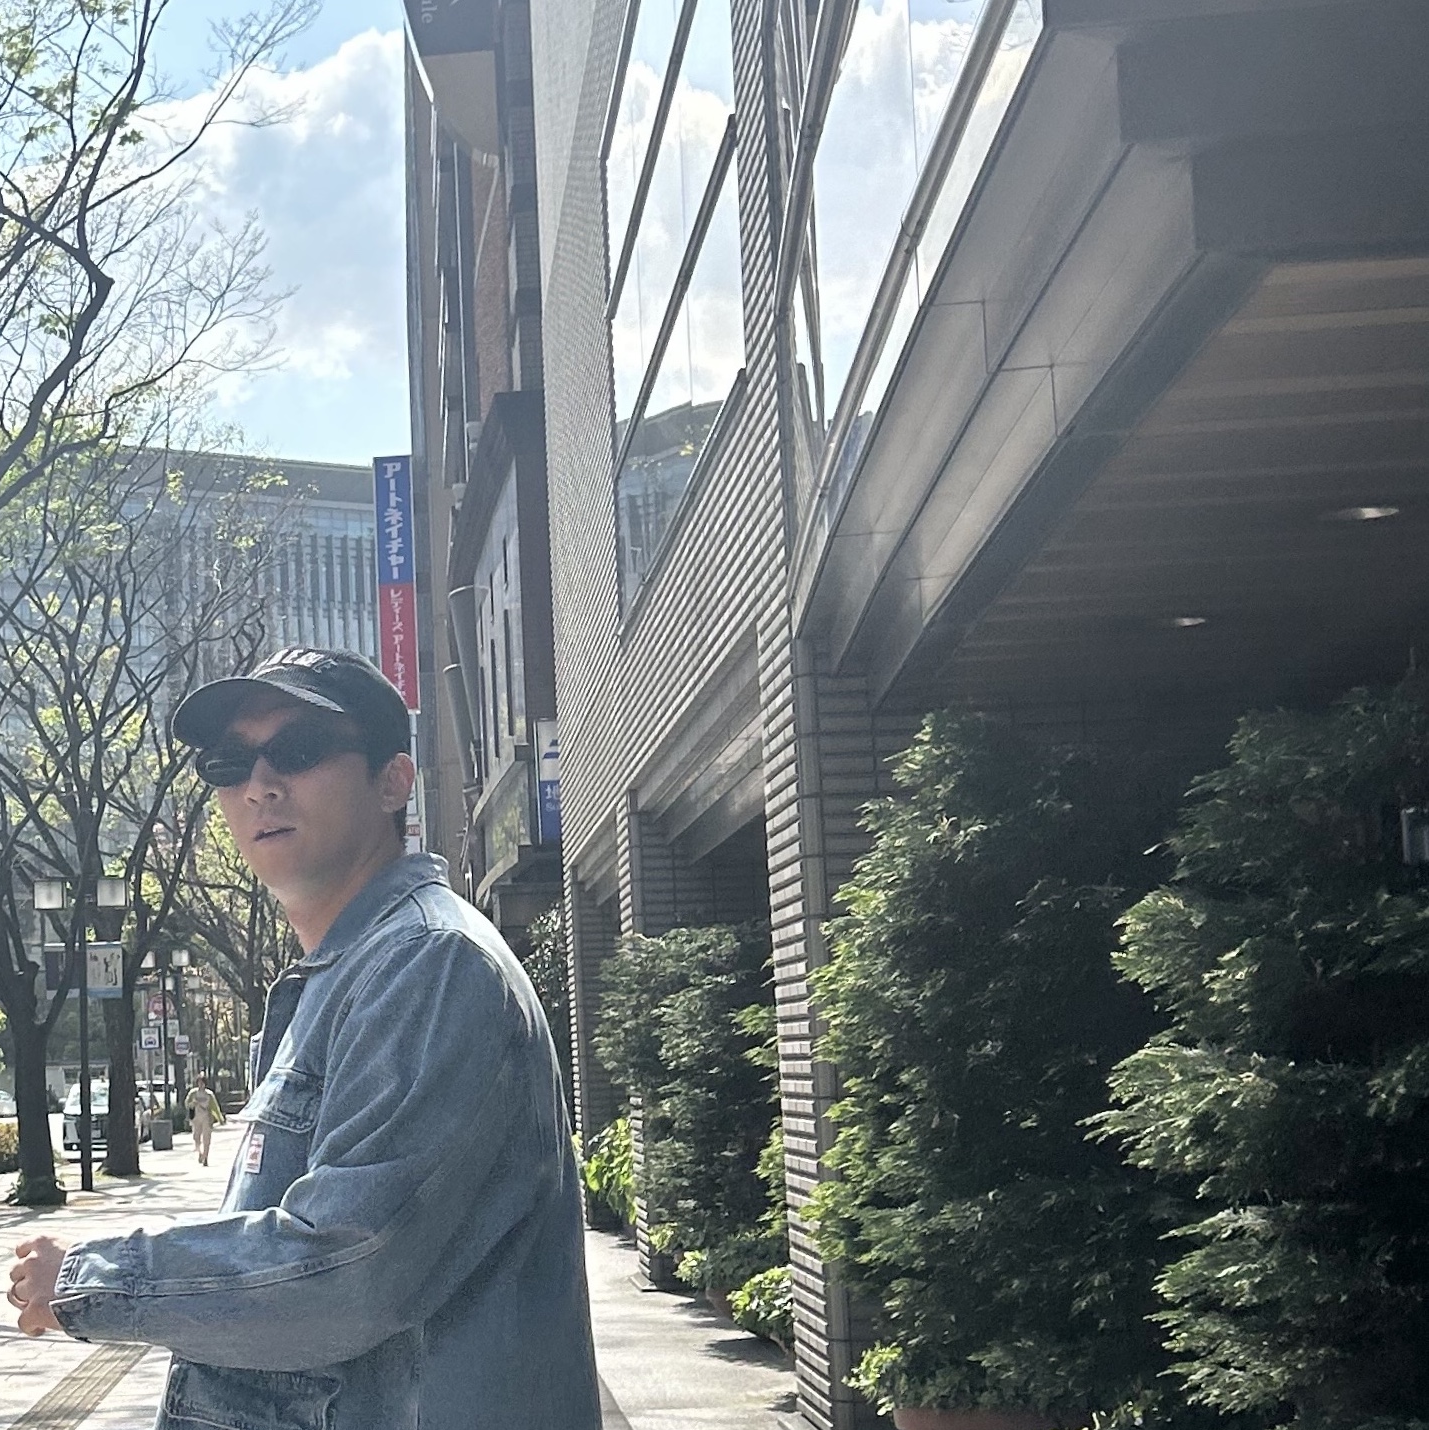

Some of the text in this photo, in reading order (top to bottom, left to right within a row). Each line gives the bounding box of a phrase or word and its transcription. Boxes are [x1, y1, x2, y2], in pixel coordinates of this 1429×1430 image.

[382, 461, 406, 580] アートネイチャー
[391, 588, 407, 697] レディースアートネイチャ
